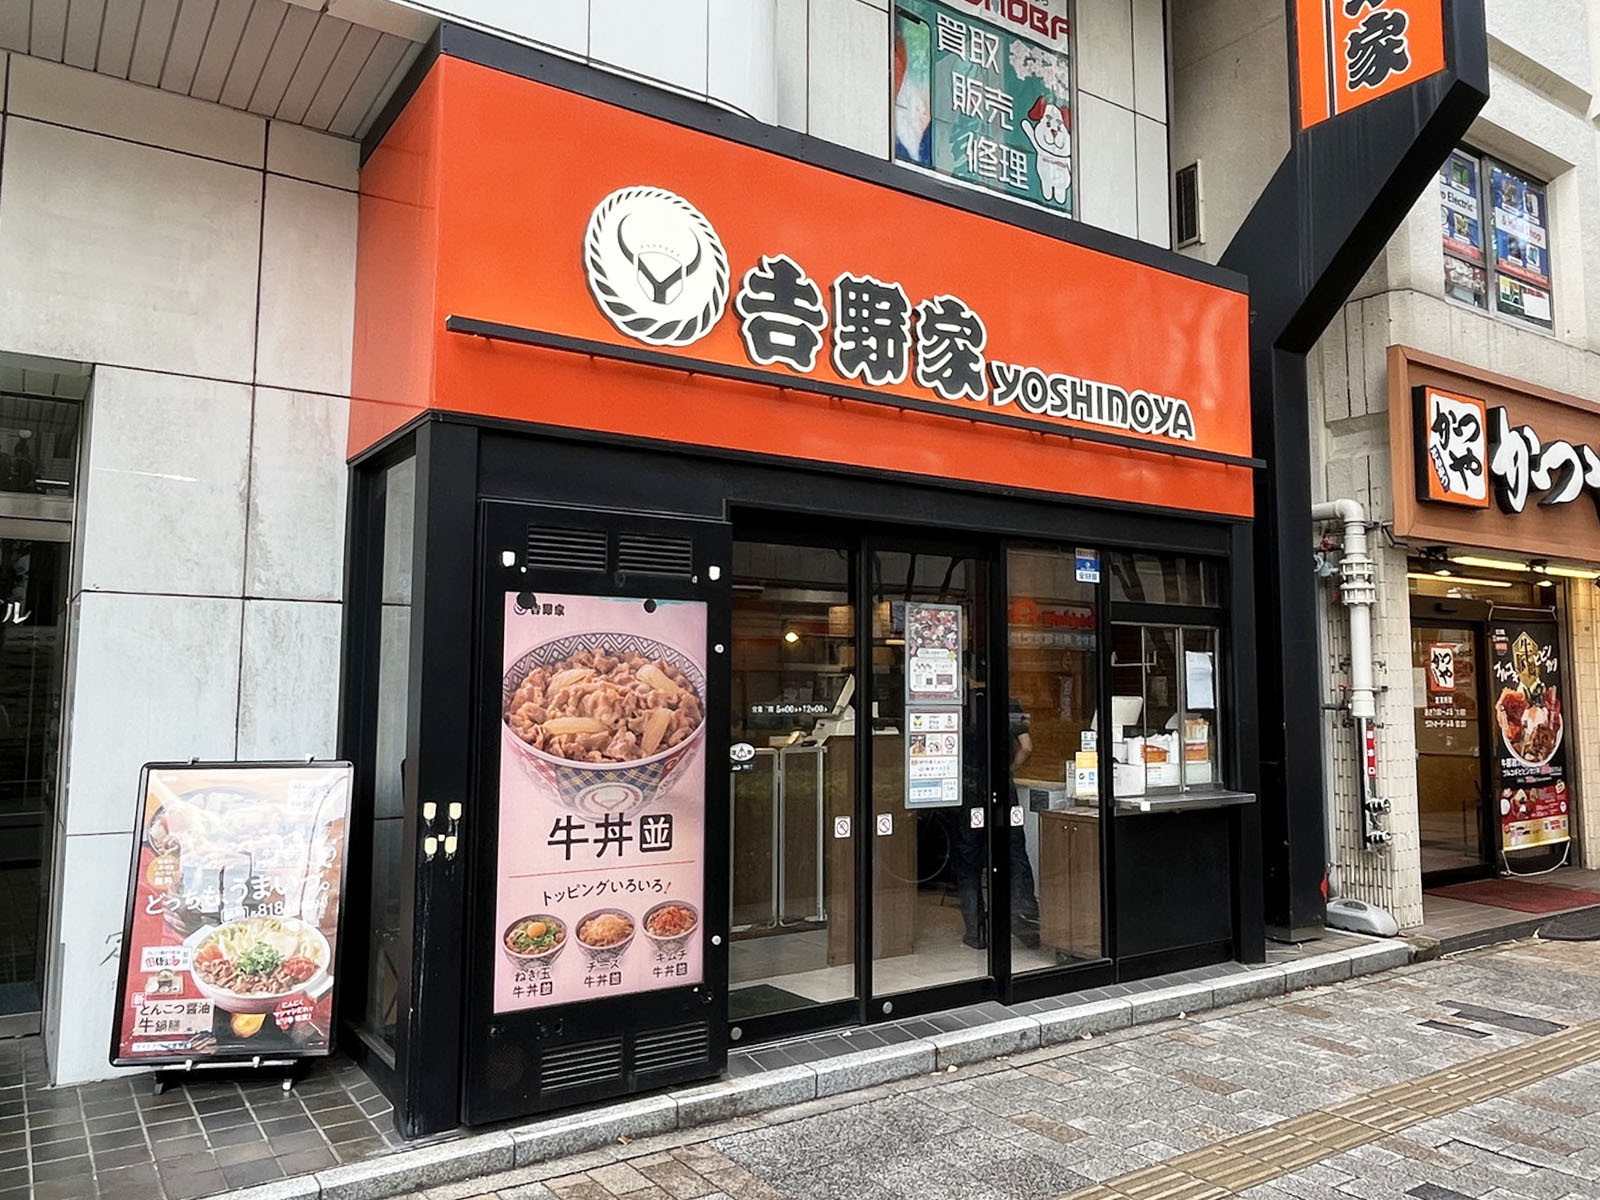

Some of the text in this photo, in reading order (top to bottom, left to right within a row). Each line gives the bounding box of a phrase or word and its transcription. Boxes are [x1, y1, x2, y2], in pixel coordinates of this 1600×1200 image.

[936, 12, 999, 74] 買取
[952, 70, 1014, 131] 販売
[959, 132, 1030, 191] 修理
[990, 362, 1196, 441] YOSHINOYA
[1491, 405, 1600, 513] かつ
[140, 1002, 211, 1016] とんこつ醤油
